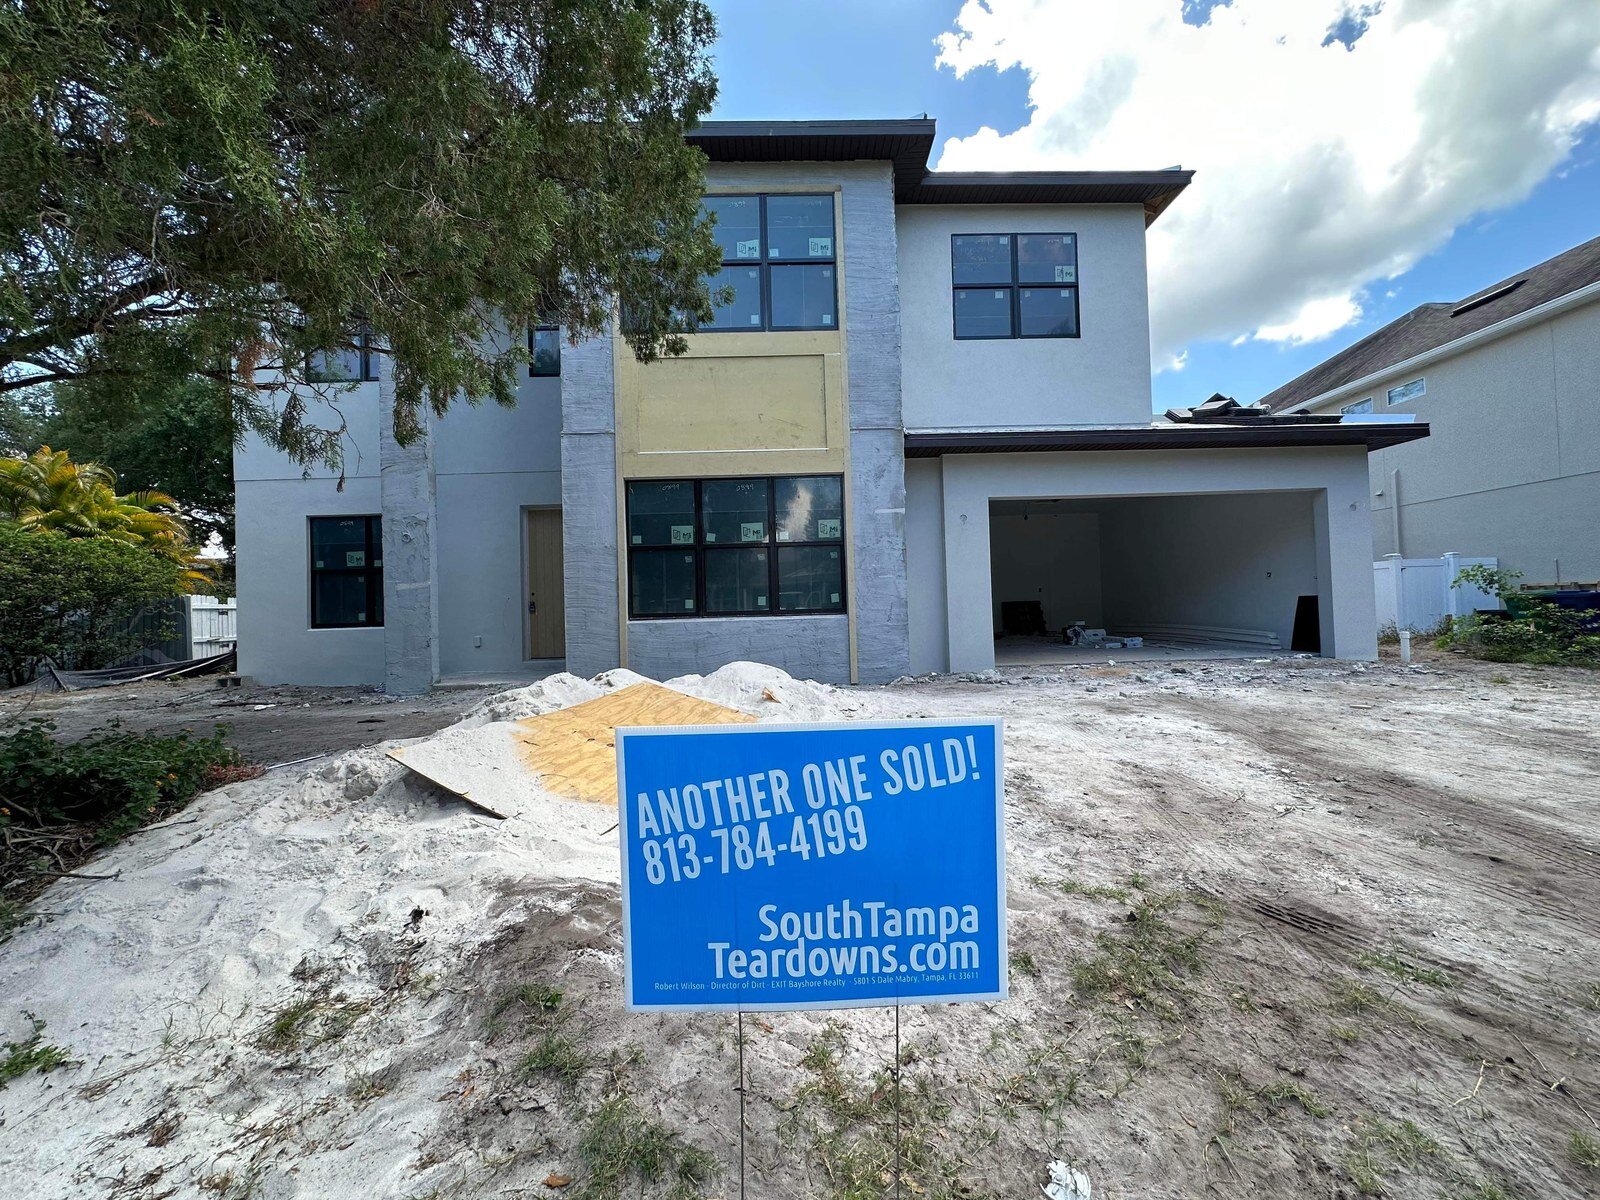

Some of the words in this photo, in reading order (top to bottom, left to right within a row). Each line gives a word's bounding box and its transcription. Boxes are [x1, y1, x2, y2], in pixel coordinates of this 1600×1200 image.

[637, 769, 795, 839] ANOTHER
[803, 754, 873, 810] ONE
[879, 735, 981, 796] SOLD!
[642, 805, 868, 885] 813-784-4199
[758, 899, 979, 943] SouthTampa
[707, 936, 980, 979] Teardowns.com
[654, 982, 679, 990] Robert
[680, 981, 705, 990] Wilson
[711, 981, 740, 989] Director
[741, 980, 749, 989] of
[751, 980, 766, 989] Dirt
[771, 980, 786, 988] EXIT
[788, 979, 822, 989] Bayshore
[823, 978, 846, 988] Realty
[853, 977, 870, 985] 5801
[871, 976, 876, 984] S
[877, 975, 894, 984] Dale
[895, 974, 920, 984] Mabry,
[921, 973, 947, 983] Tampa,
[948, 972, 957, 980] FL
[958, 971, 979, 979] 33611
